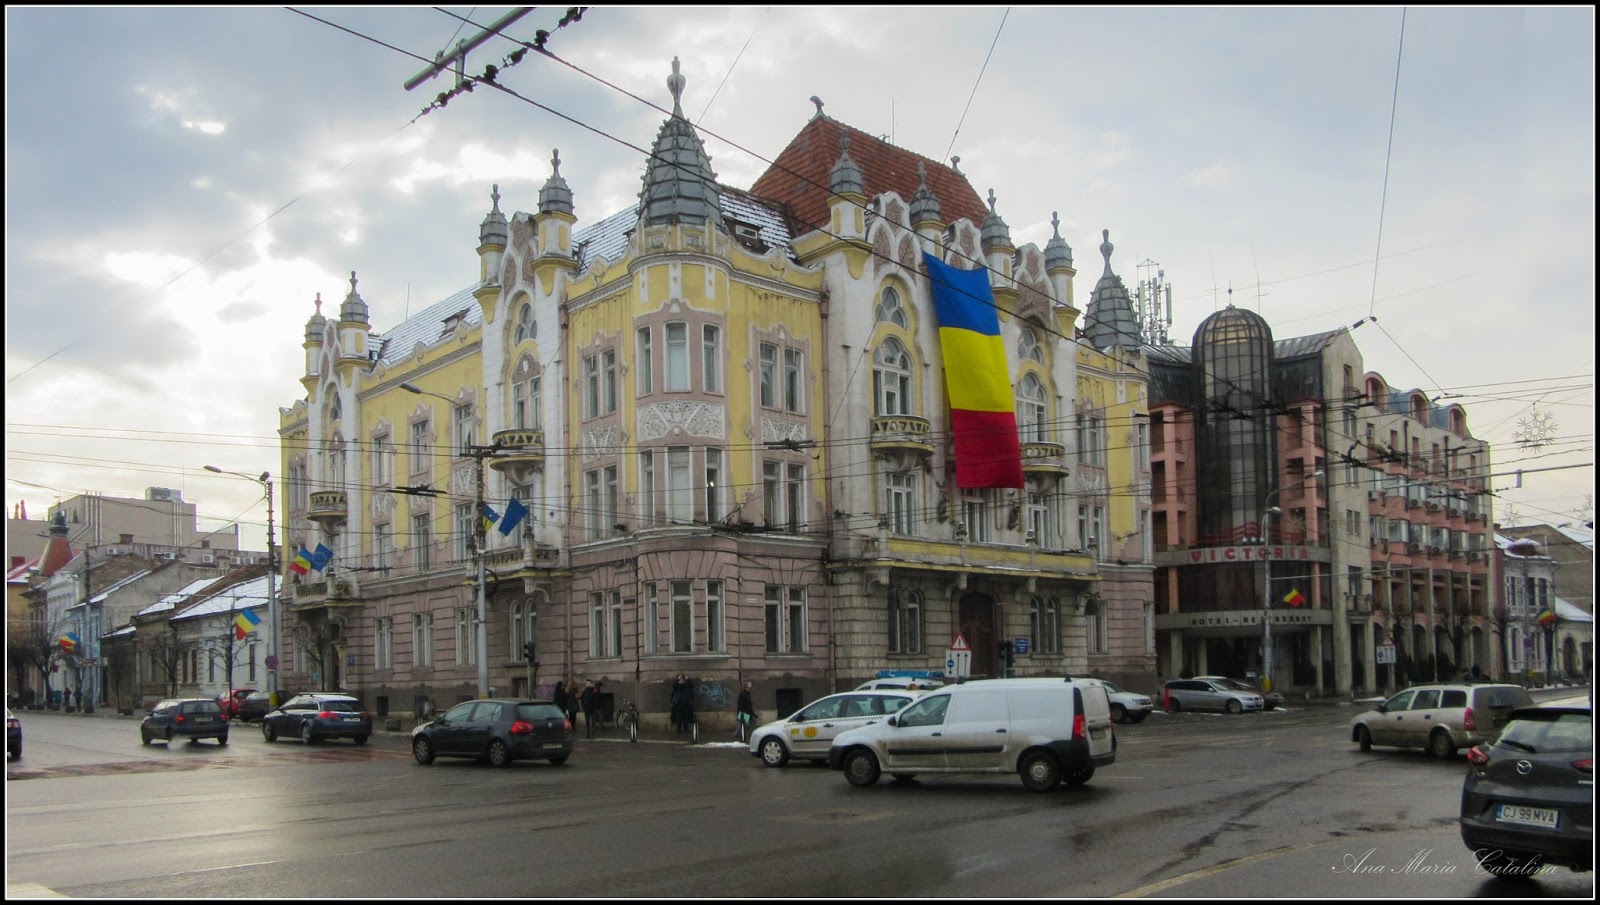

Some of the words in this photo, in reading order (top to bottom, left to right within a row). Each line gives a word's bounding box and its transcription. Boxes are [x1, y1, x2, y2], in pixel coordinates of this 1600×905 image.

[1190, 547, 1310, 562] VICTORIA
[1503, 806, 1517, 818] CJ
[1519, 808, 1532, 820] 99
[1533, 809, 1555, 823] MVA
